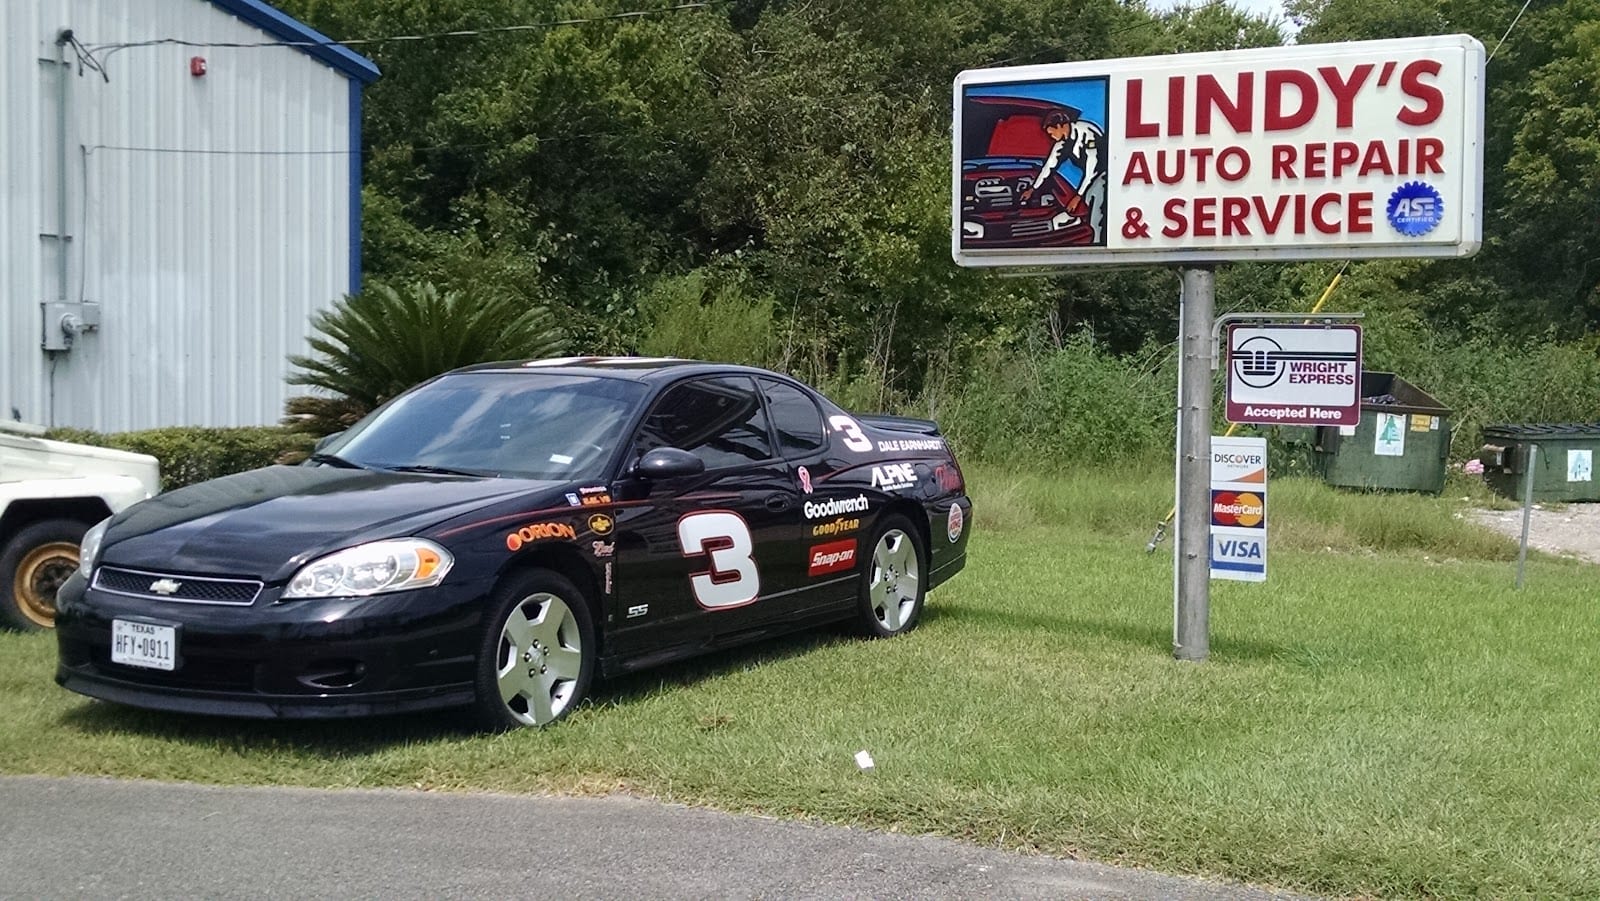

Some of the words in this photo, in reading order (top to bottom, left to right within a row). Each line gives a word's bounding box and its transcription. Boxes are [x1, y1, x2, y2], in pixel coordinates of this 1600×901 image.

[1126, 59, 1444, 138] LINDY'S
[1123, 145, 1251, 185] AUTO
[1272, 138, 1445, 179] REPAIR
[1122, 207, 1151, 239] &
[1163, 192, 1374, 238] SERVICE
[1393, 197, 1435, 217] ASE
[1290, 362, 1347, 373] WRIGHT
[1289, 374, 1354, 385] EXPRESS
[1244, 406, 1306, 419] Accepted
[1309, 408, 1342, 419] Here
[829, 415, 873, 452] 3
[877, 440, 900, 452] DALE
[1214, 454, 1261, 465] DISCOVER
[804, 493, 869, 519] Goodwrench
[1213, 503, 1262, 515] MasterCard
[518, 522, 577, 542] ORION
[811, 549, 854, 567] Snap-on
[1219, 540, 1261, 558] VISA
[676, 509, 760, 611] 3
[132, 624, 155, 635] TEXAS
